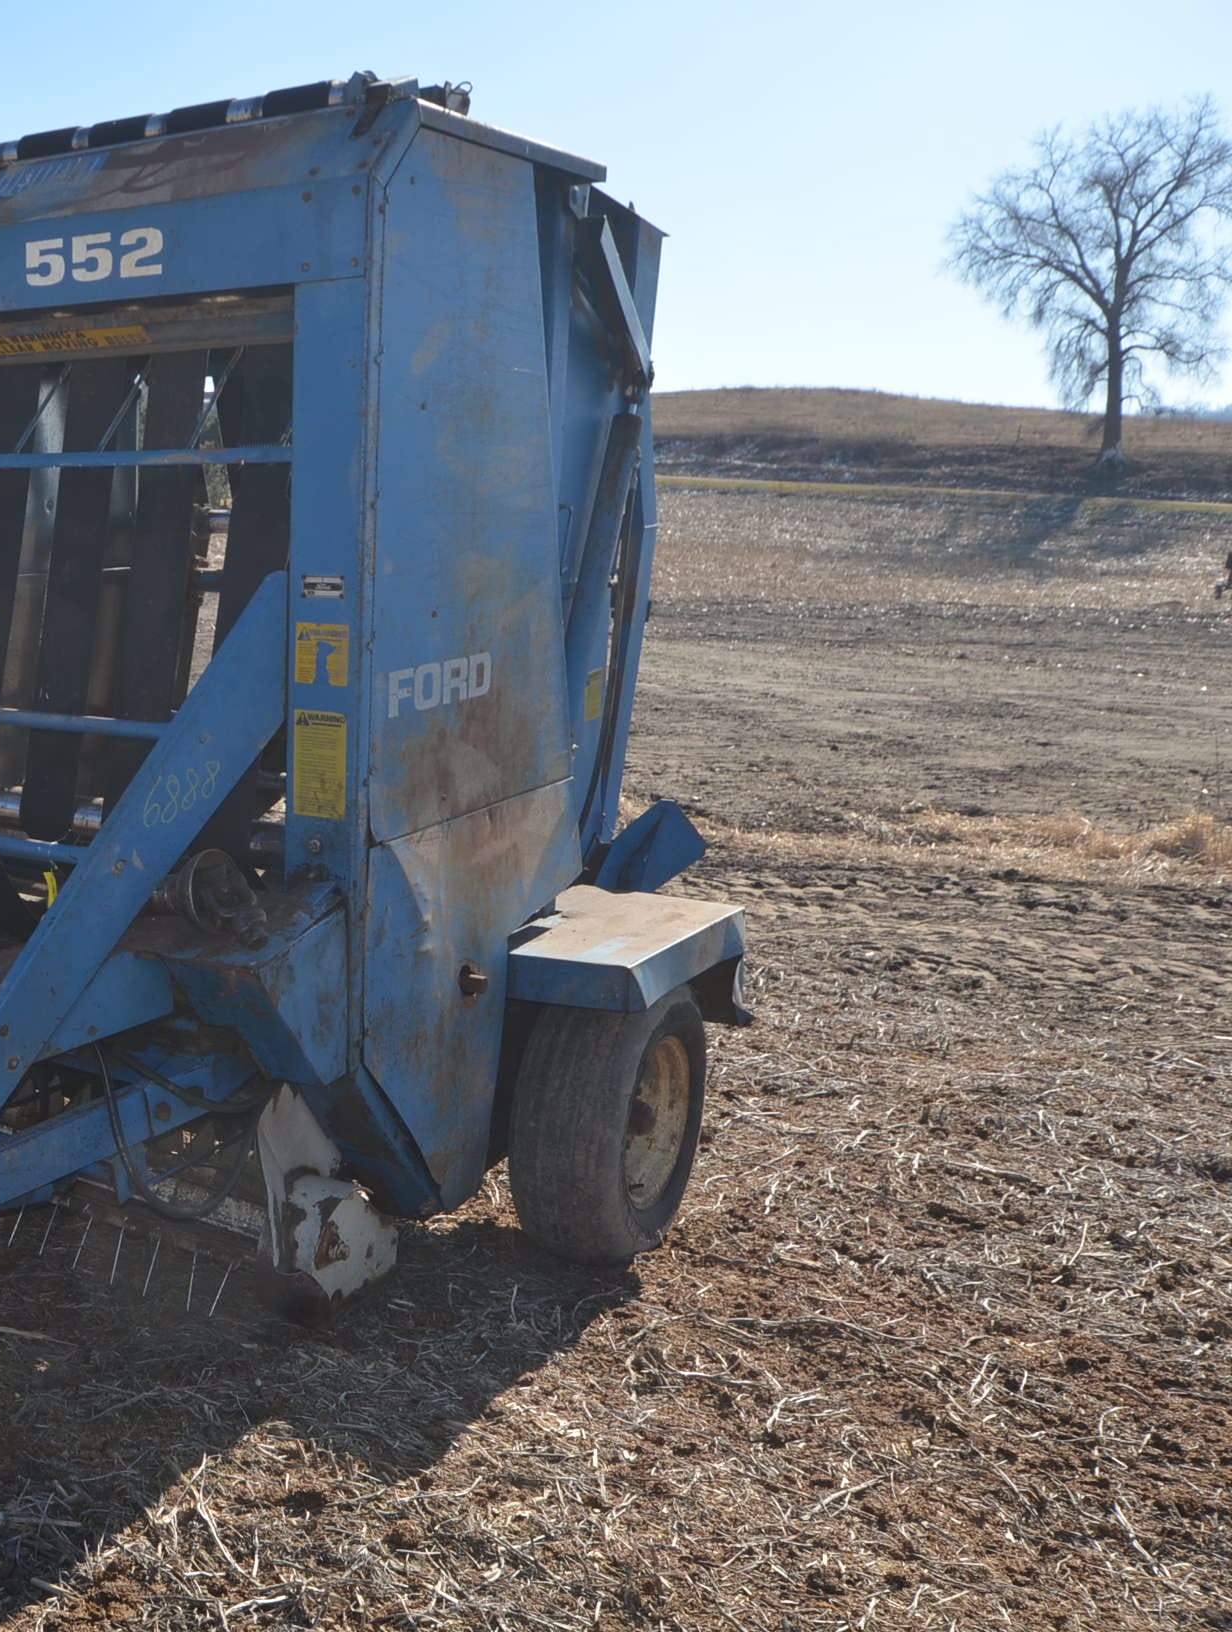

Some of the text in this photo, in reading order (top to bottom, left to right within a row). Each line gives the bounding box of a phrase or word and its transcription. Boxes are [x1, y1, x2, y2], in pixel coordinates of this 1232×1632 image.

[25, 227, 163, 287] 552
[41, 337, 99, 351] MOVING
[388, 651, 492, 719] FORD
[143, 759, 222, 829] 6888
